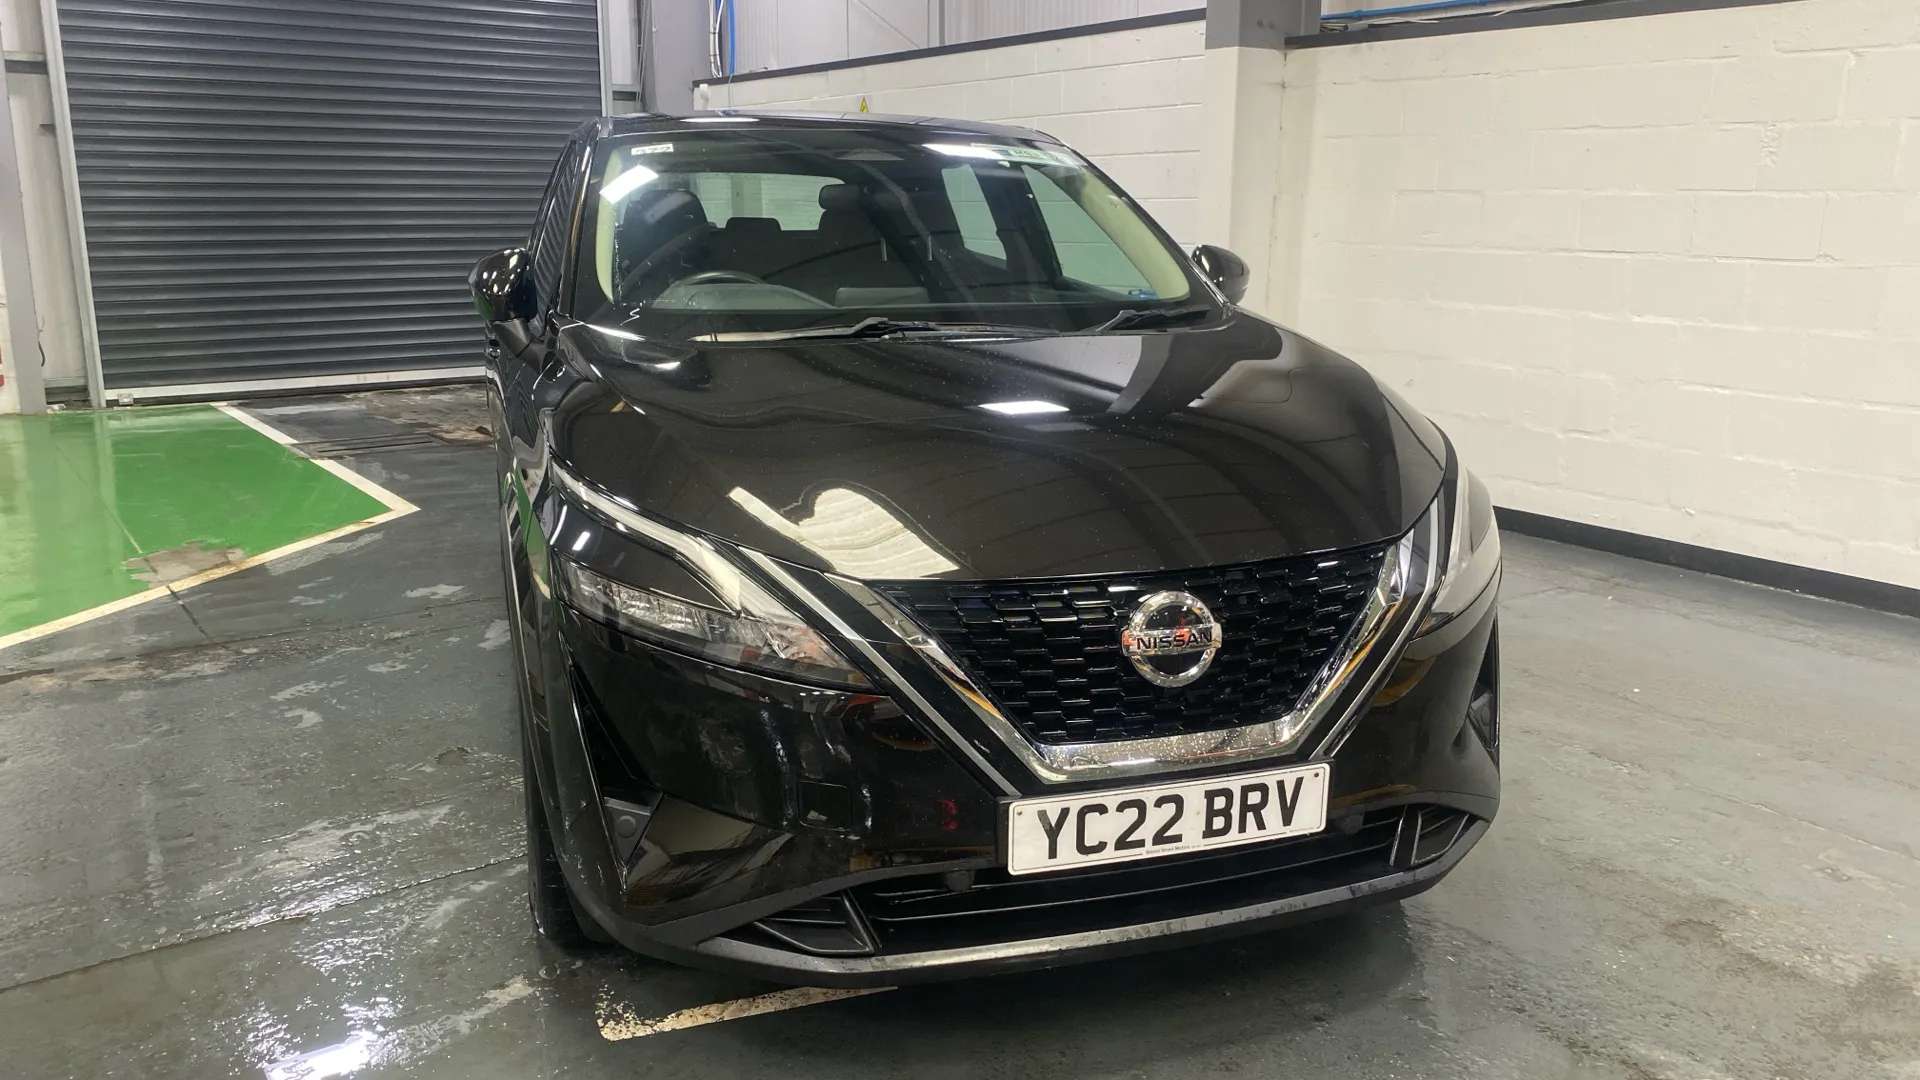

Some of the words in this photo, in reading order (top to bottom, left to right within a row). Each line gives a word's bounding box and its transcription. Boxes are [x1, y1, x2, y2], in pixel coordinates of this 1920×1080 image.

[1136, 631, 1213, 650] NISSAN
[1036, 794, 1185, 860] YC22
[1202, 776, 1305, 840] BRV
